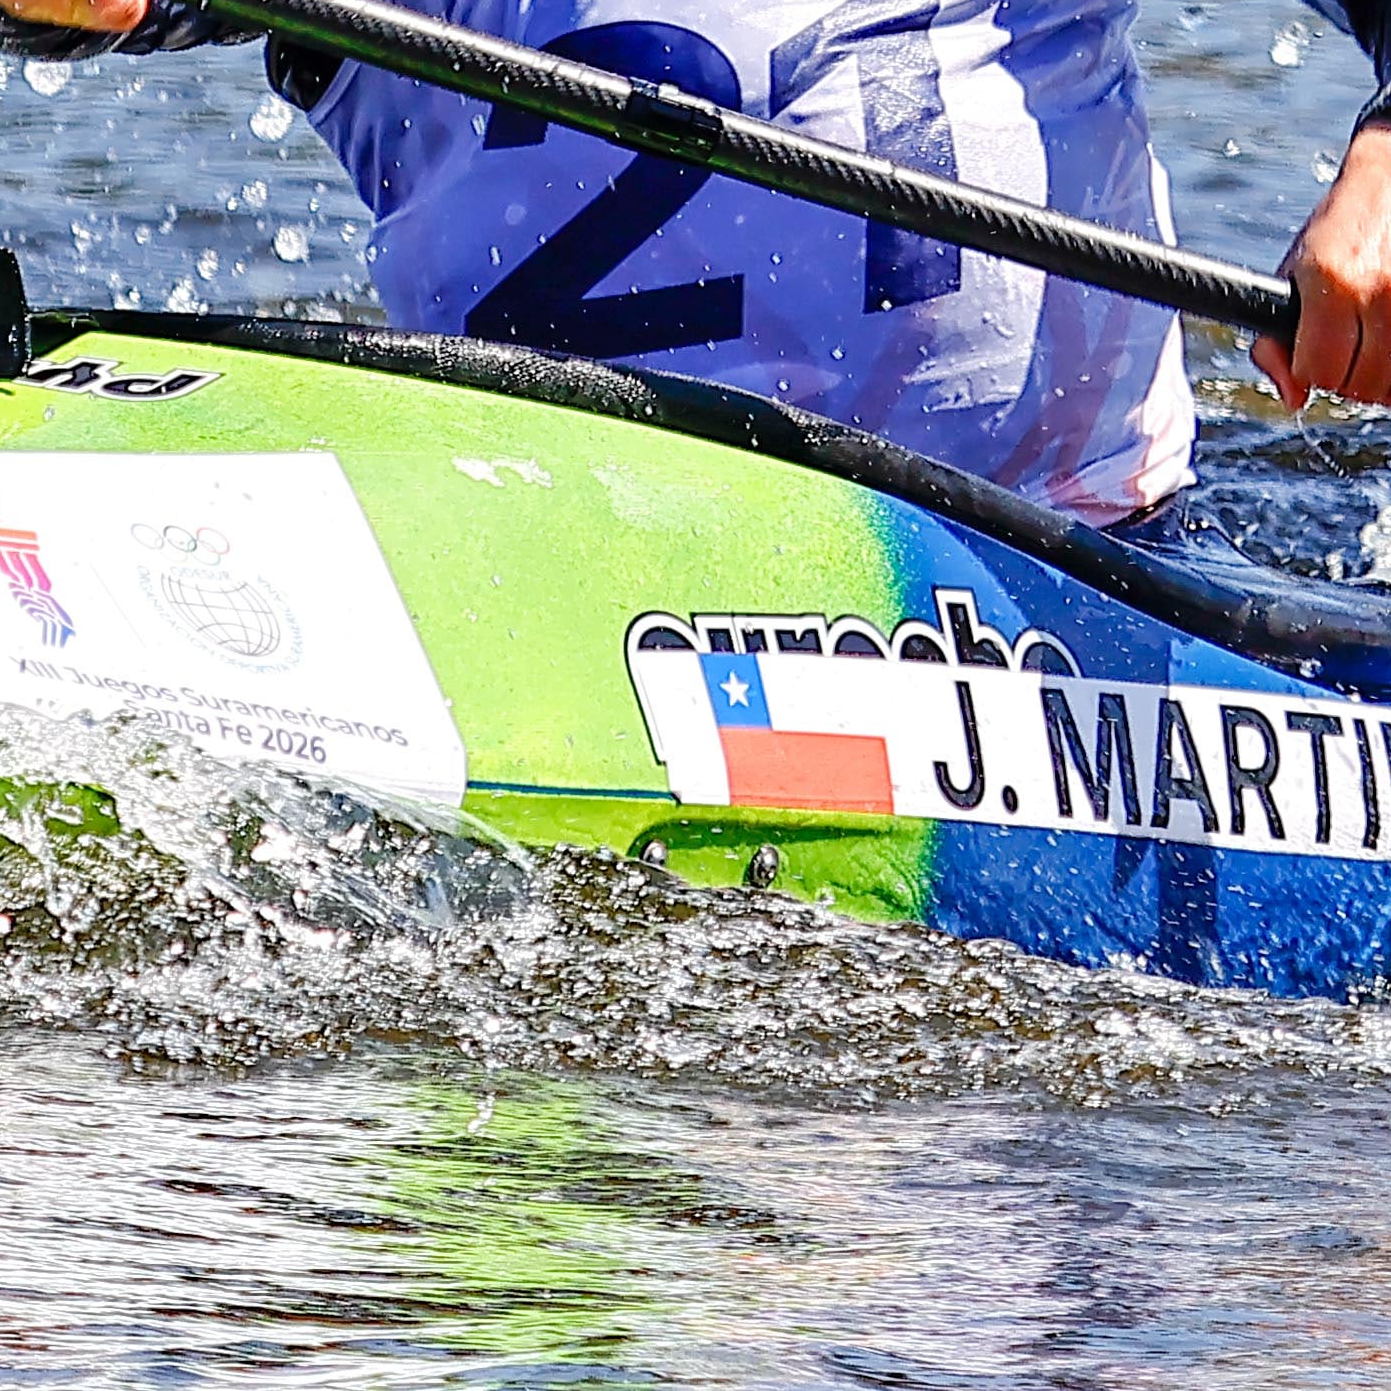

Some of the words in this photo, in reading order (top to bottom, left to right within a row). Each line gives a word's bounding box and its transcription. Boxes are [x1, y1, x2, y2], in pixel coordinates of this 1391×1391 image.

[10, 655, 63, 682] XIII
[65, 666, 180, 702] Juegos
[180, 686, 411, 748] Suramericanos
[123, 699, 211, 736] Santa
[219, 717, 253, 746] Fe
[261, 724, 328, 765] 2026
[933, 678, 1019, 815] J.
